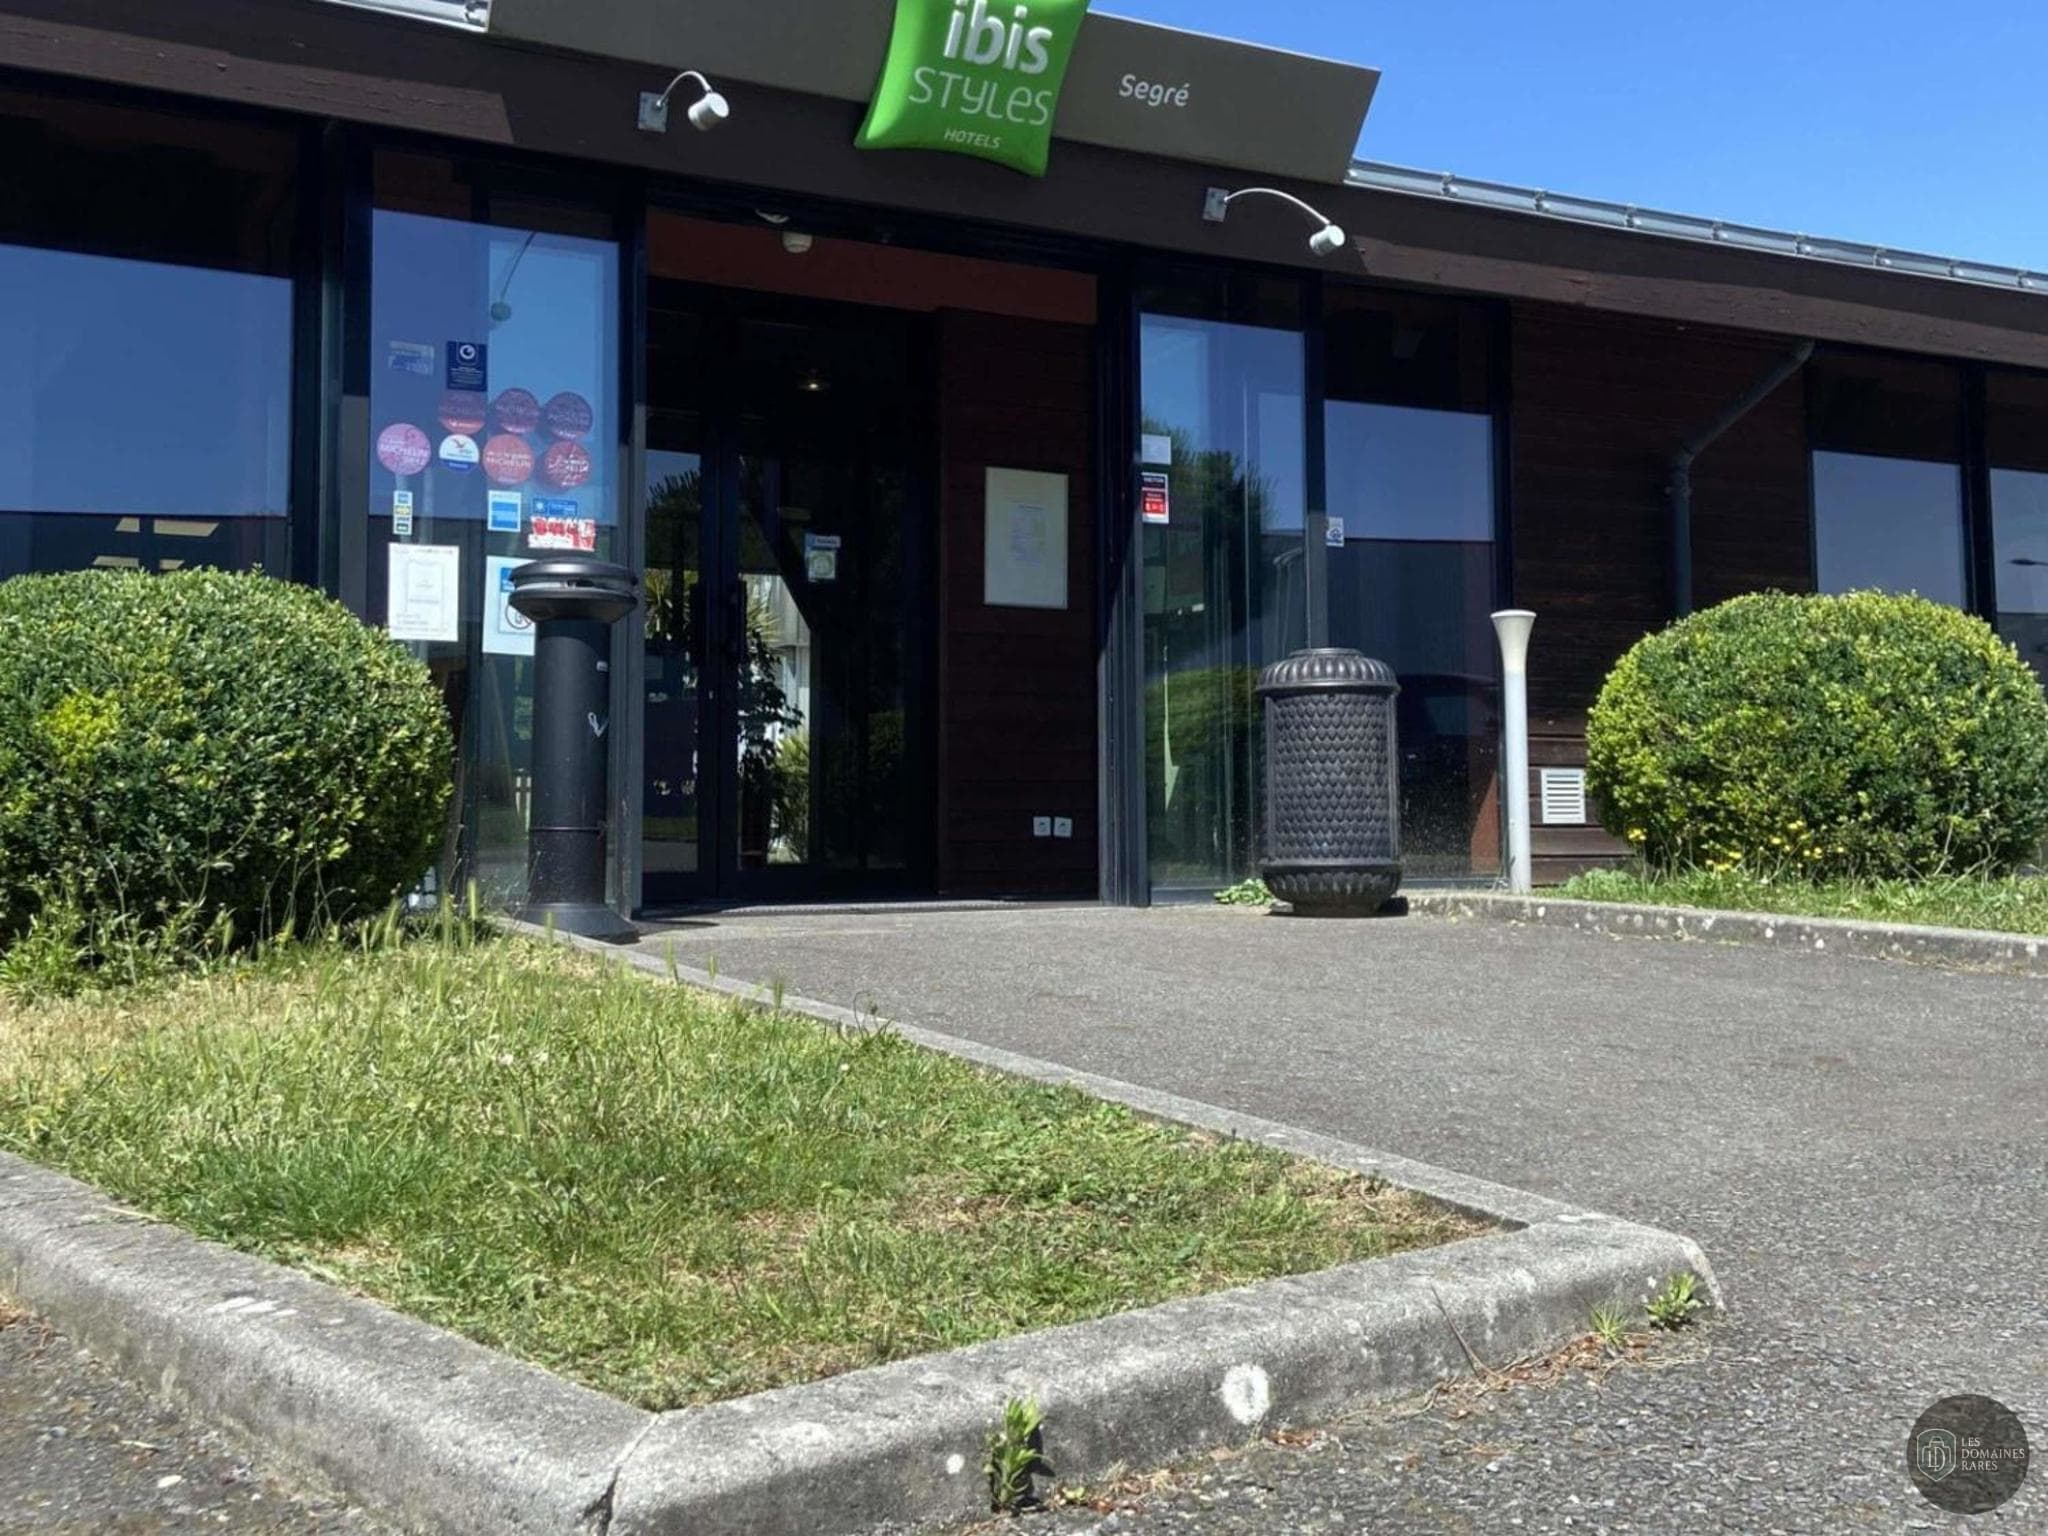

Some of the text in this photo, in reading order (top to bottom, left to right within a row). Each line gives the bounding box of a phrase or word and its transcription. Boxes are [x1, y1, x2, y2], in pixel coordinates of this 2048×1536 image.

[943, 0, 1053, 75] ibis
[1118, 74, 1192, 107] Segré
[943, 128, 1002, 149] HOTELS
